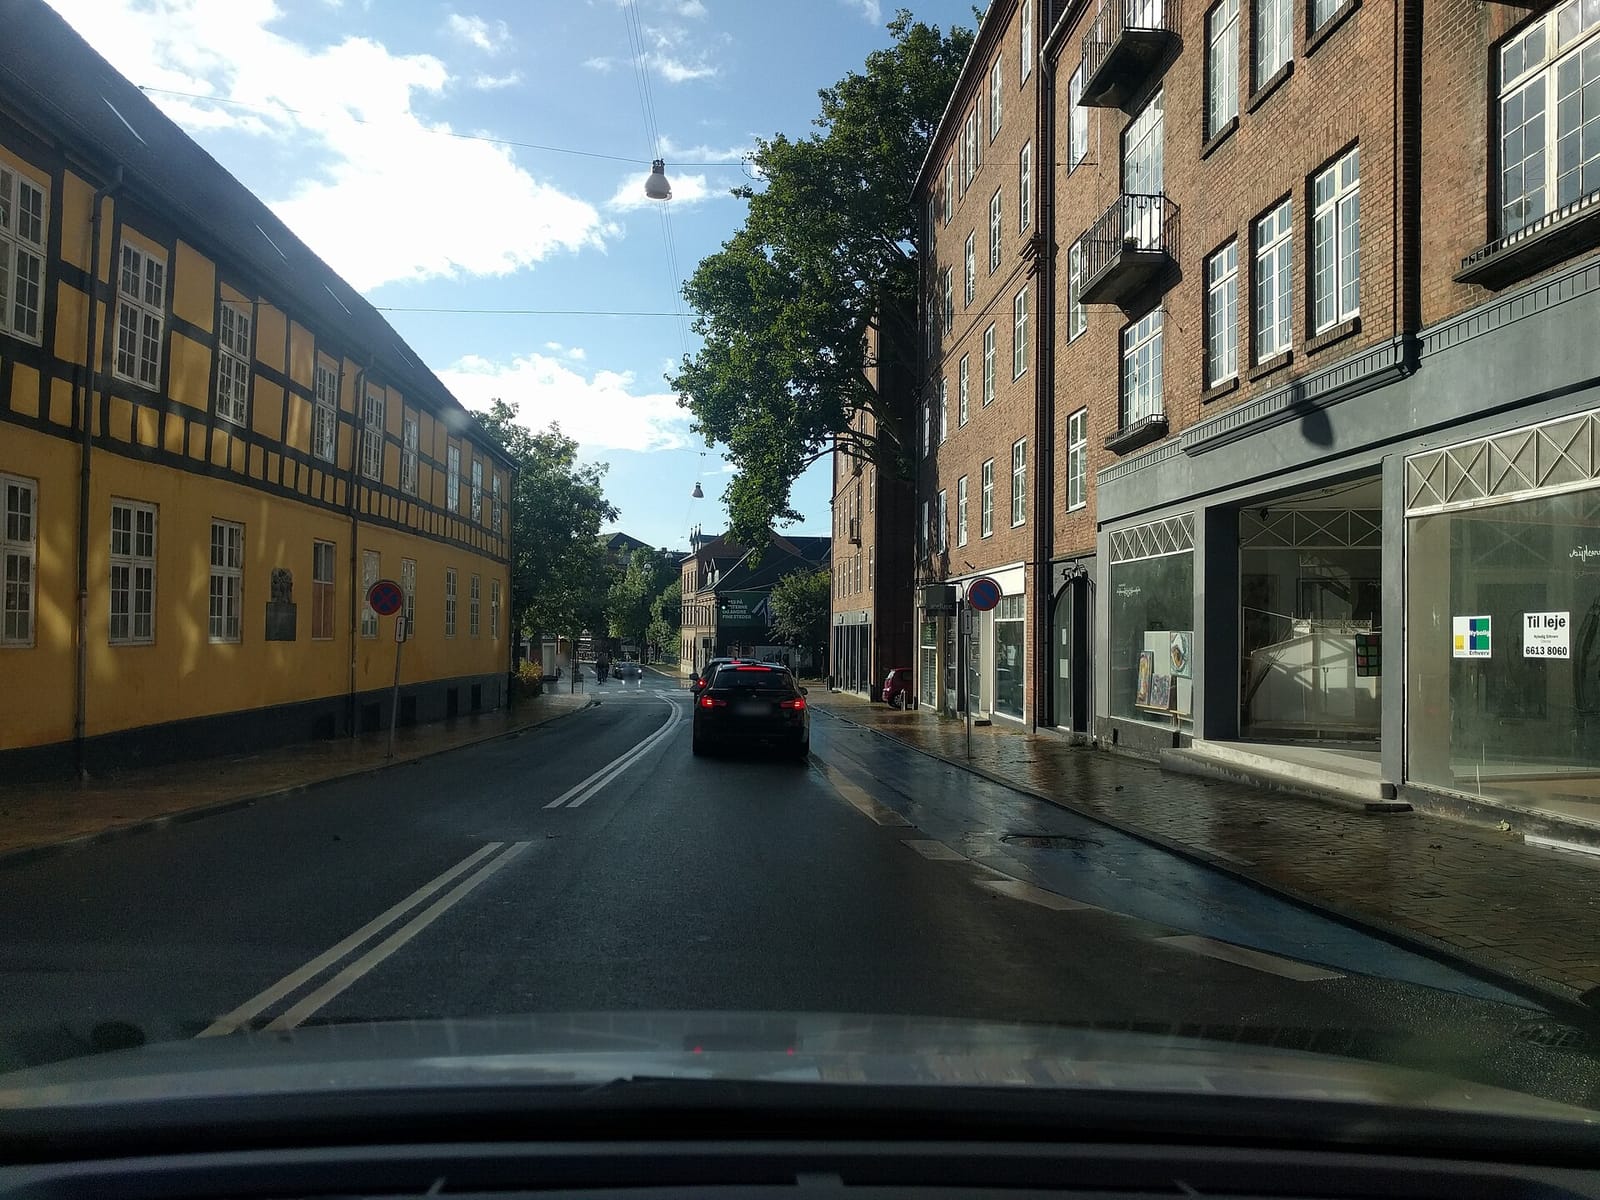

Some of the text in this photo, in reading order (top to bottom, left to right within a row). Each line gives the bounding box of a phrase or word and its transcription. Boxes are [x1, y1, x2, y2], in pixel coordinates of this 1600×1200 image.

[1527, 615, 1566, 631] Til leje
[1525, 646, 1568, 656] 6613 8060
